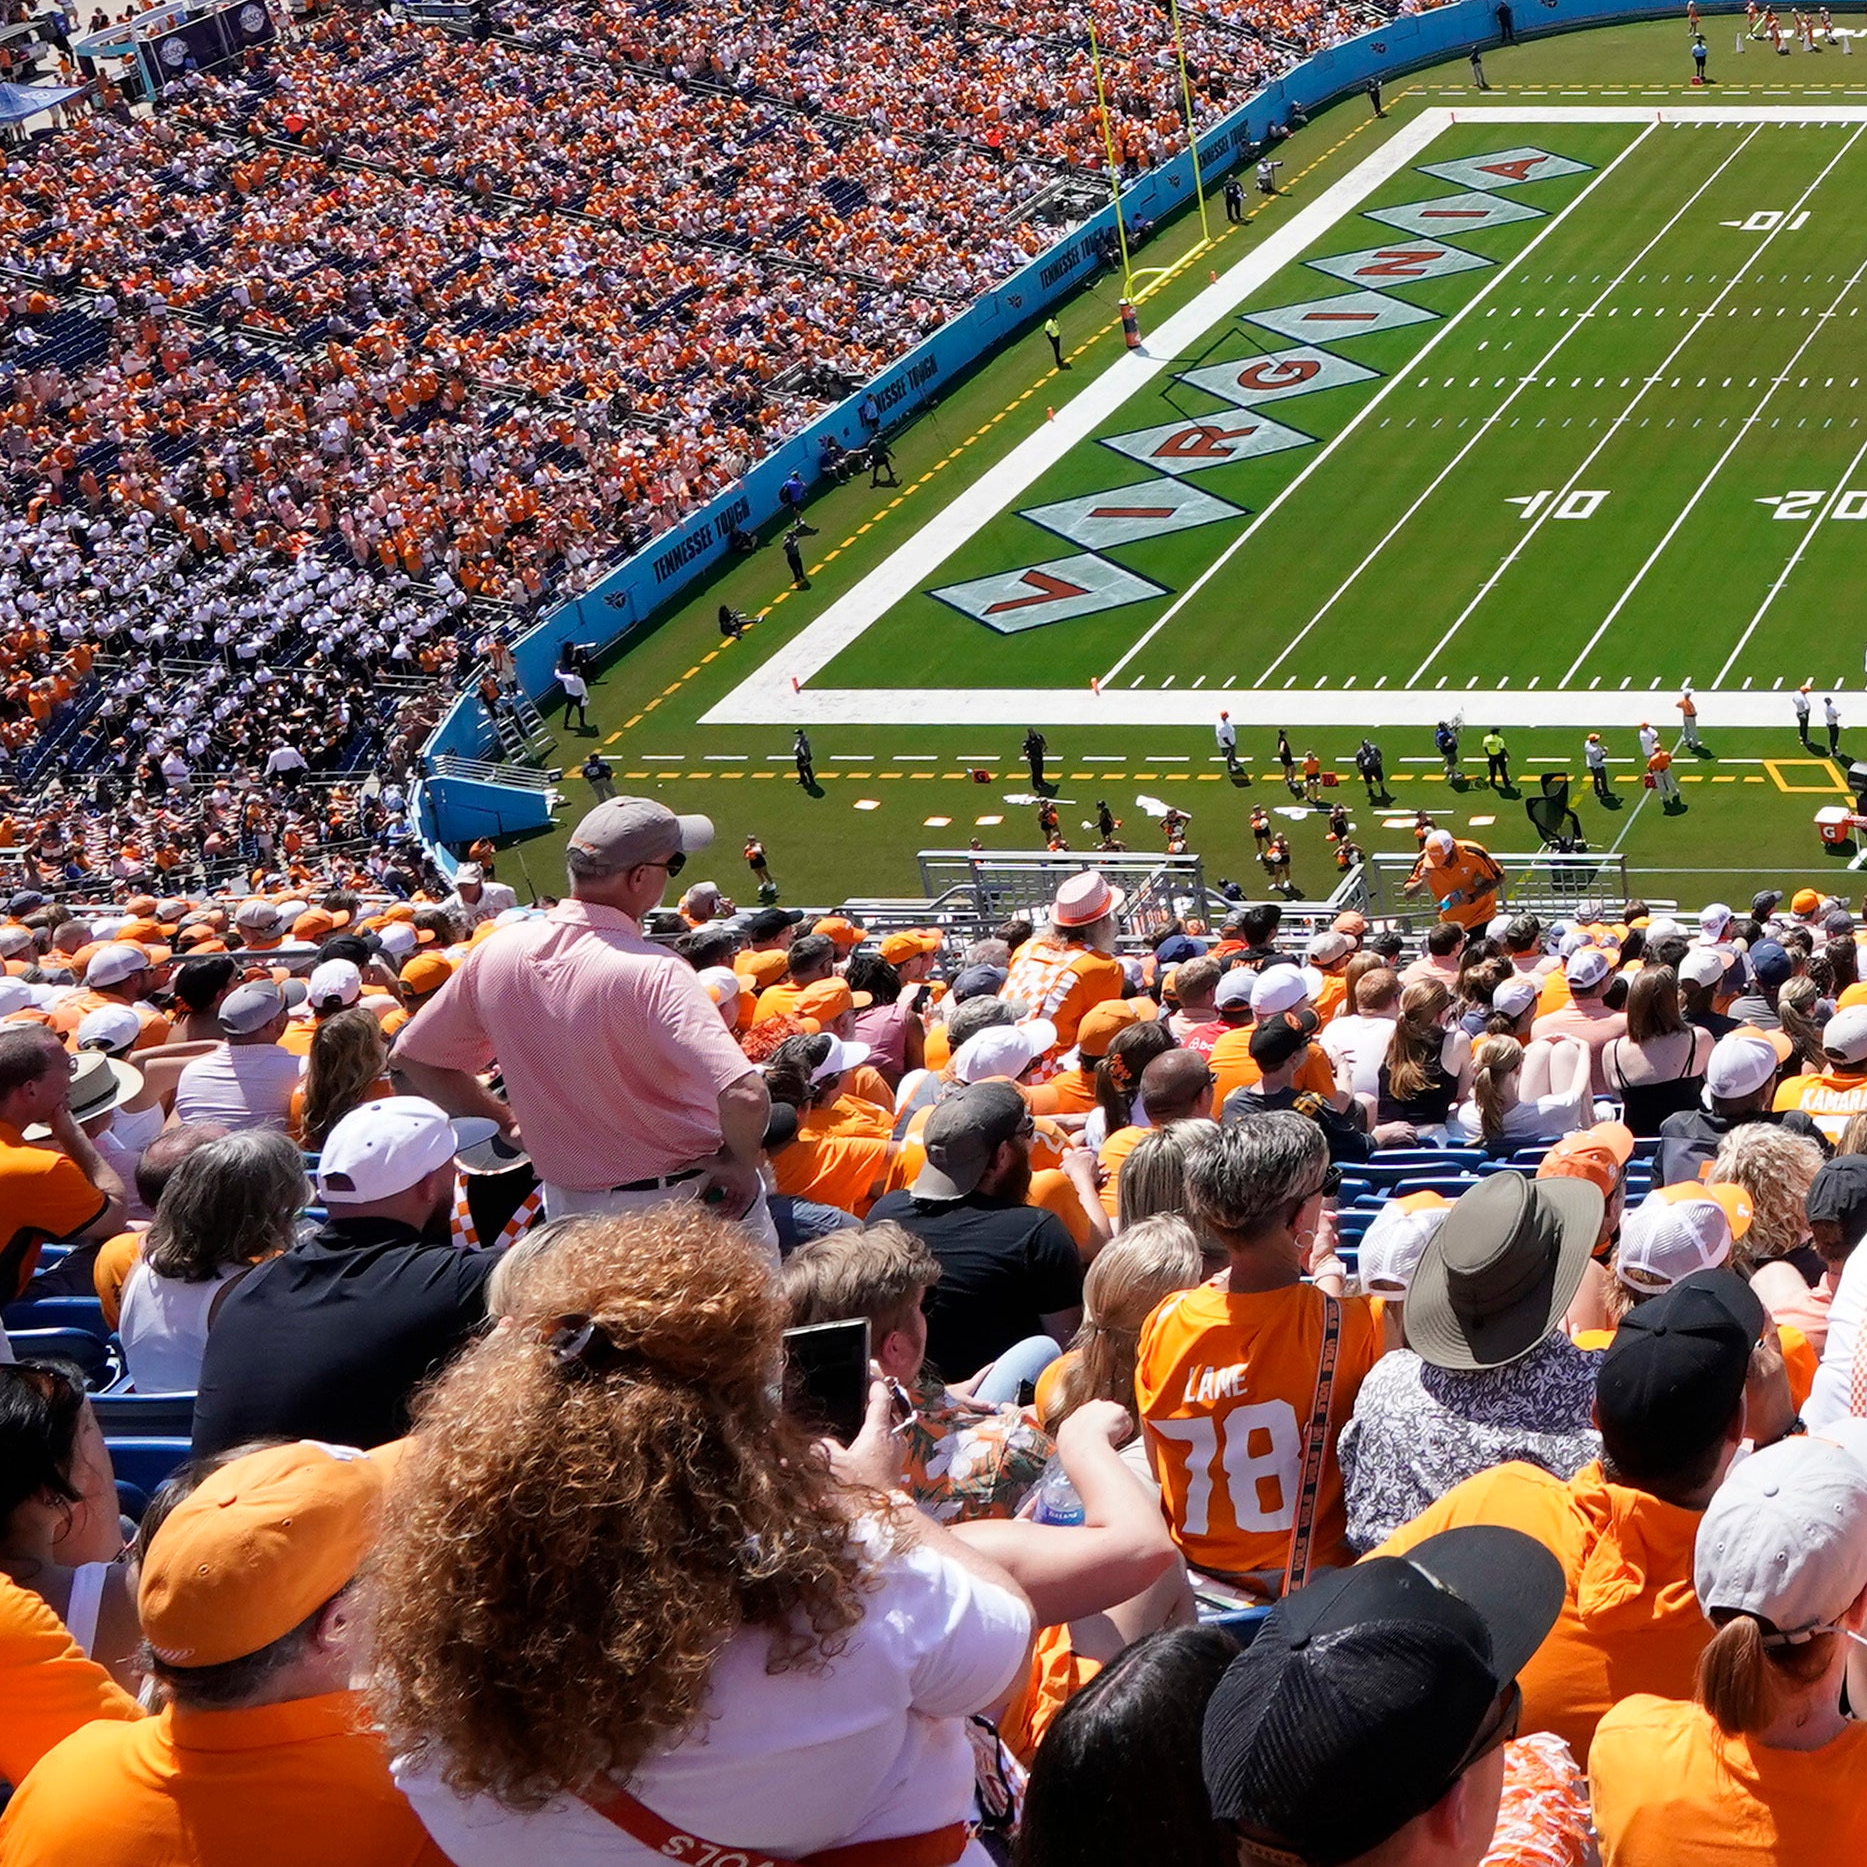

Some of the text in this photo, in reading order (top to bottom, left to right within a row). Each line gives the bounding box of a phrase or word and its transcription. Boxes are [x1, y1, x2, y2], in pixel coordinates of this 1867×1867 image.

[1518, 490, 1611, 520] 10
[652, 522, 717, 584] TENNESSEE
[1823, 826, 1836, 838] G
[1183, 1362, 1249, 1404] LANE
[1149, 1398, 1302, 1536] 78
